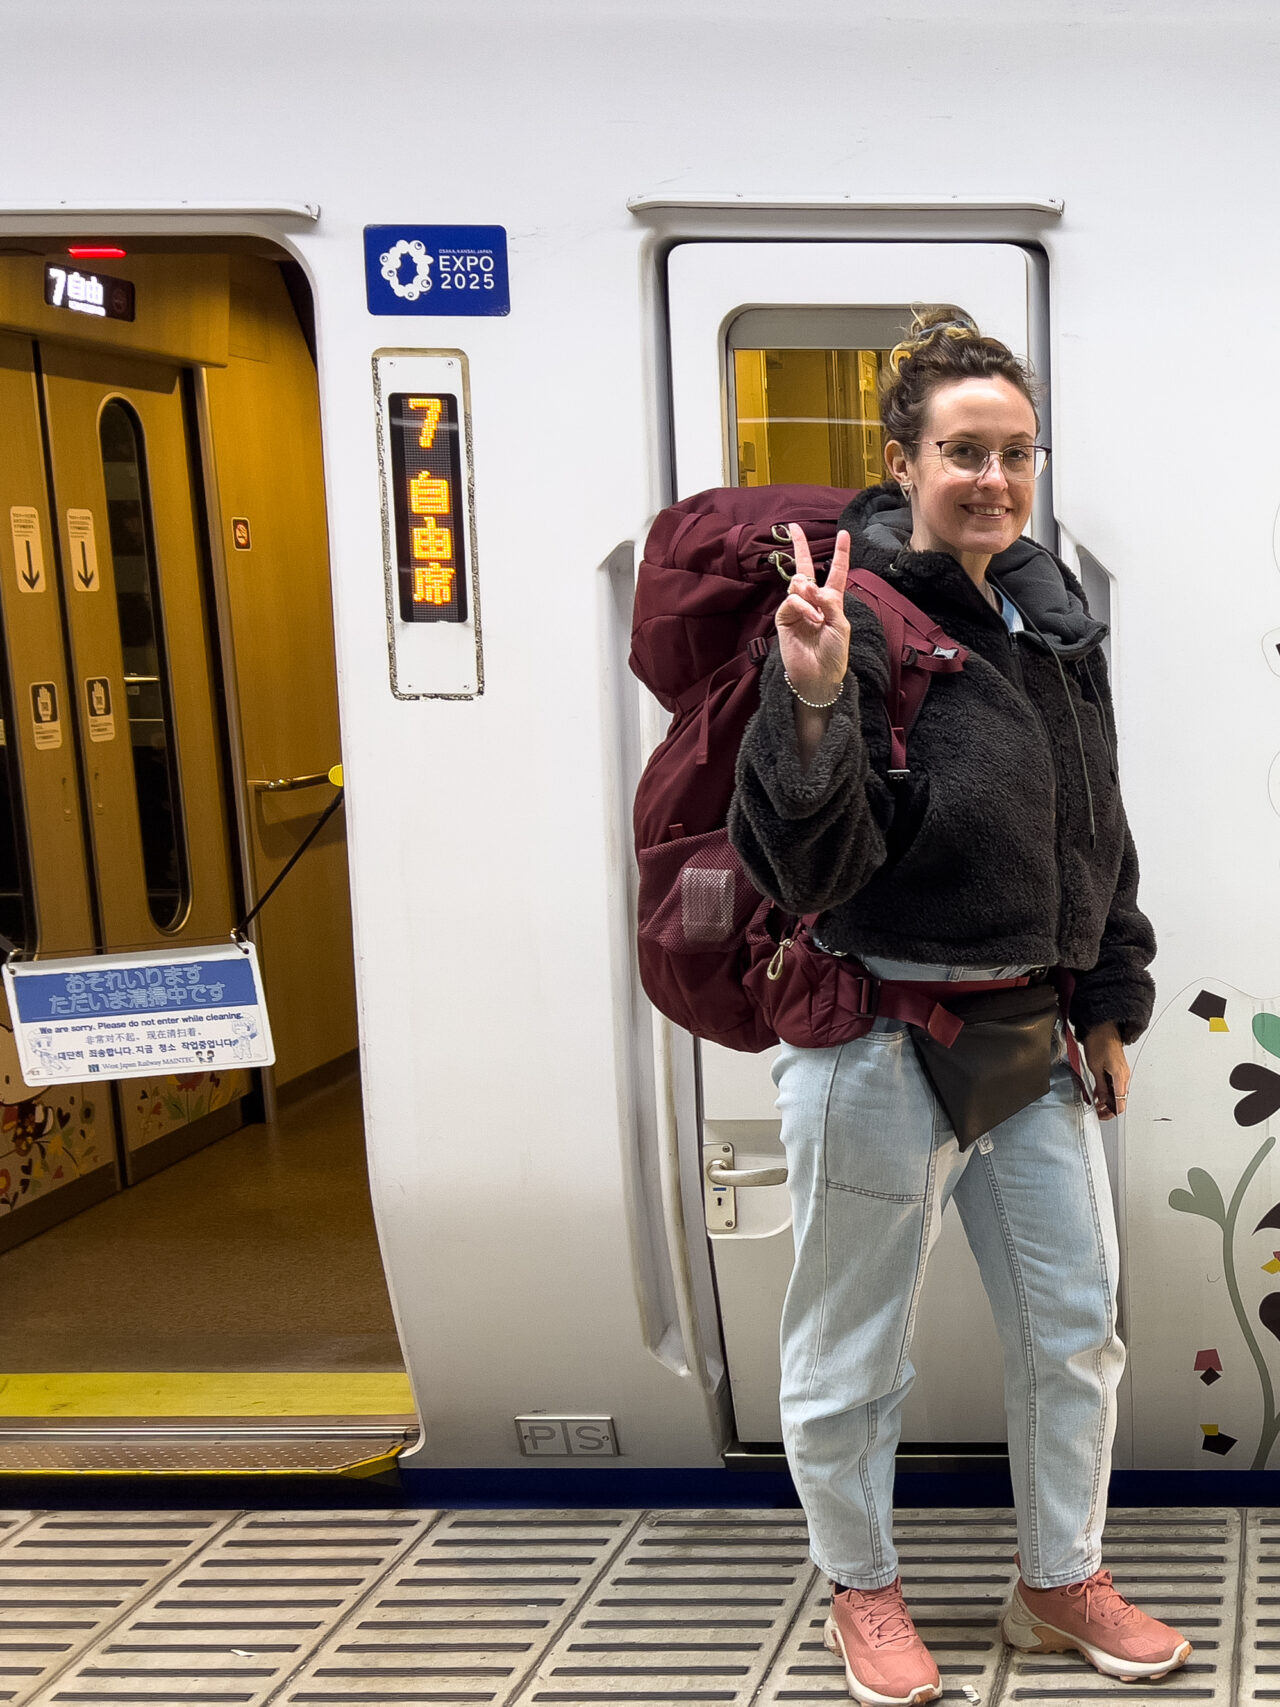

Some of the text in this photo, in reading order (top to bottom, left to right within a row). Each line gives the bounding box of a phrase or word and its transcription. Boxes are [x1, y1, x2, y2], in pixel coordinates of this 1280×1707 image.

[439, 255, 495, 272] EXPO
[49, 268, 67, 306] 7
[440, 273, 495, 290] 2025
[408, 397, 456, 606] 7 自由席
[64, 964, 203, 994] おそれいります
[48, 981, 225, 1015] ただいま清掃中です
[39, 1011, 245, 1035] We are sorry. Please do not enter while cleaning.
